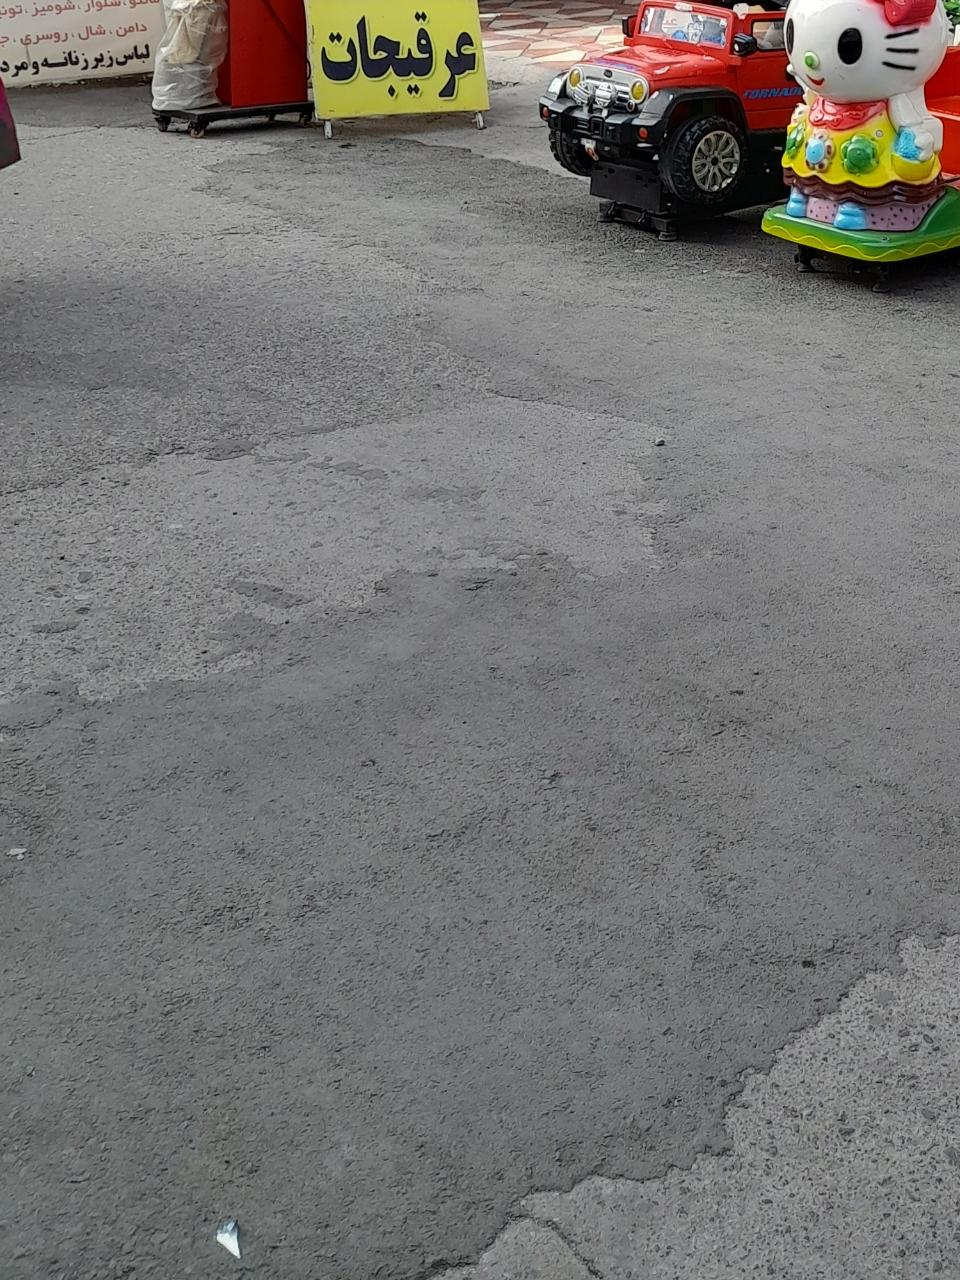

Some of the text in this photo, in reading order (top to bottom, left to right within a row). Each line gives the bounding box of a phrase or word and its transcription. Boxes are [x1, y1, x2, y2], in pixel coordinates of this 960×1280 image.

[0, 44, 150, 78] لباس زیر زنانه و مرد
[321, 10, 477, 98] عرقیجات
[743, 87, 803, 99] TORNAD
